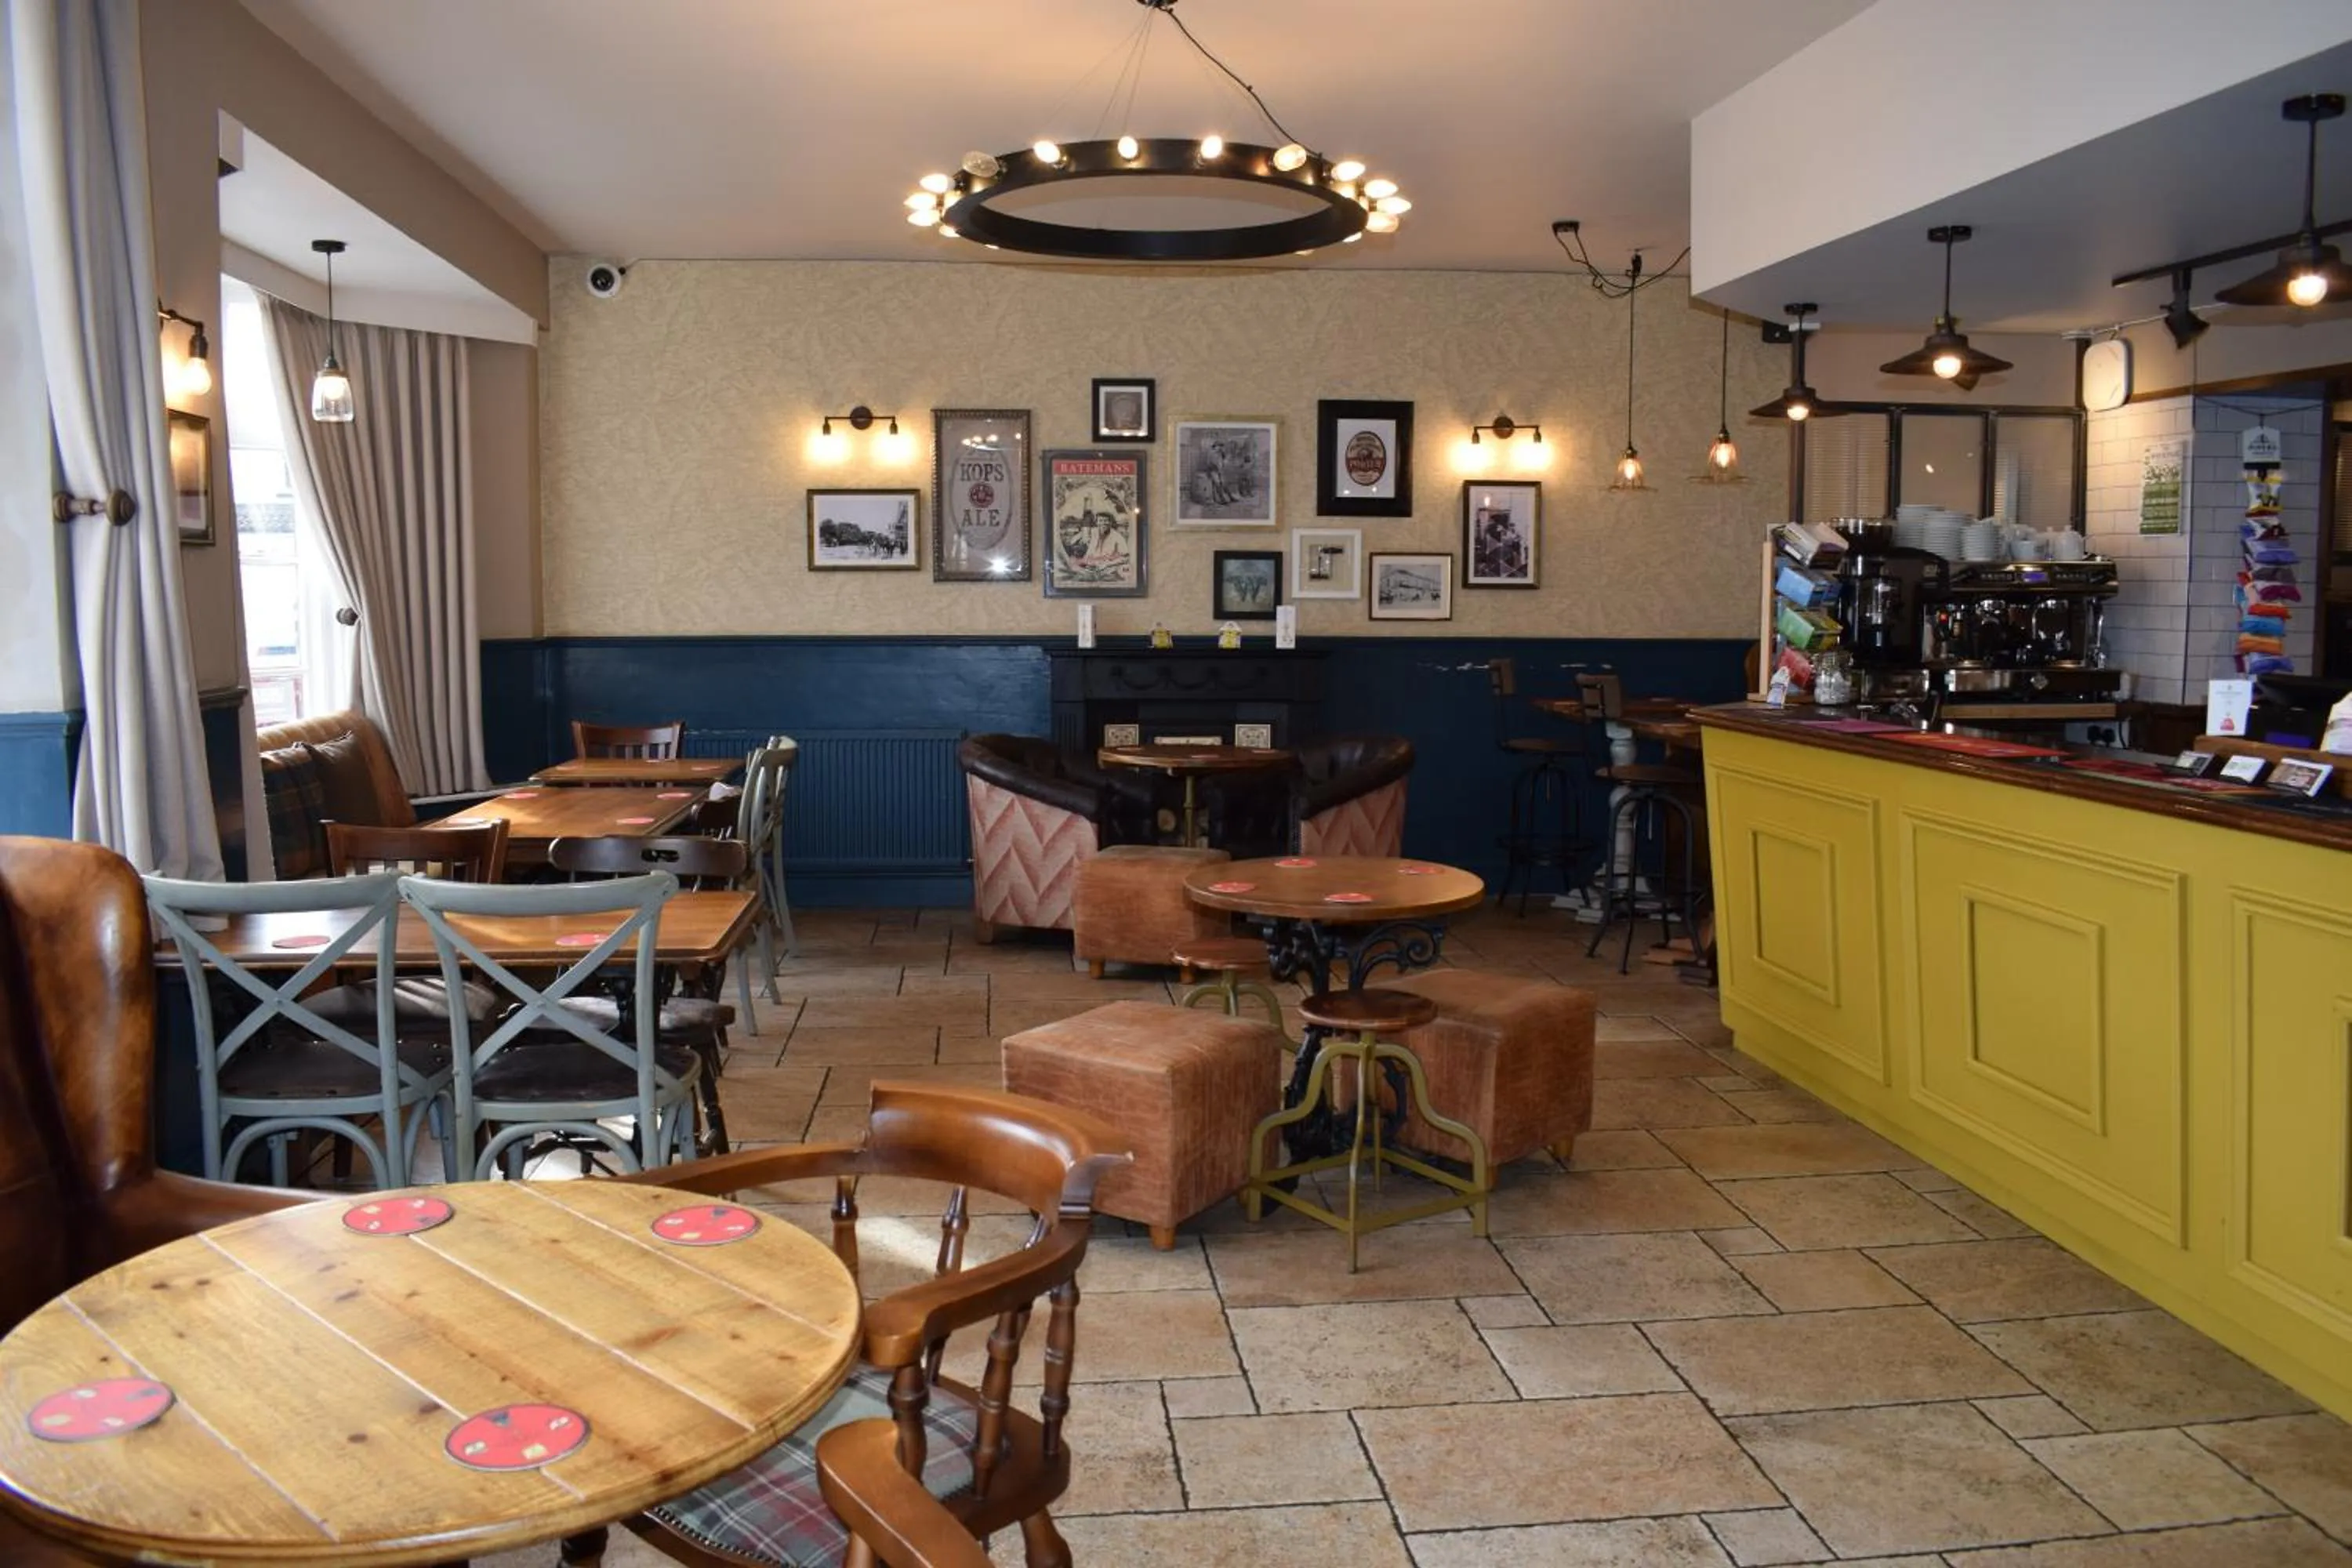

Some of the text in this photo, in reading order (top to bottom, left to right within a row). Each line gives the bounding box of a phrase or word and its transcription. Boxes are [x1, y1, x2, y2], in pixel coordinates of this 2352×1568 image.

[960, 463, 1004, 481] KOPS
[1060, 463, 1131, 474] BATEMANS
[961, 509, 1000, 527] ALE
